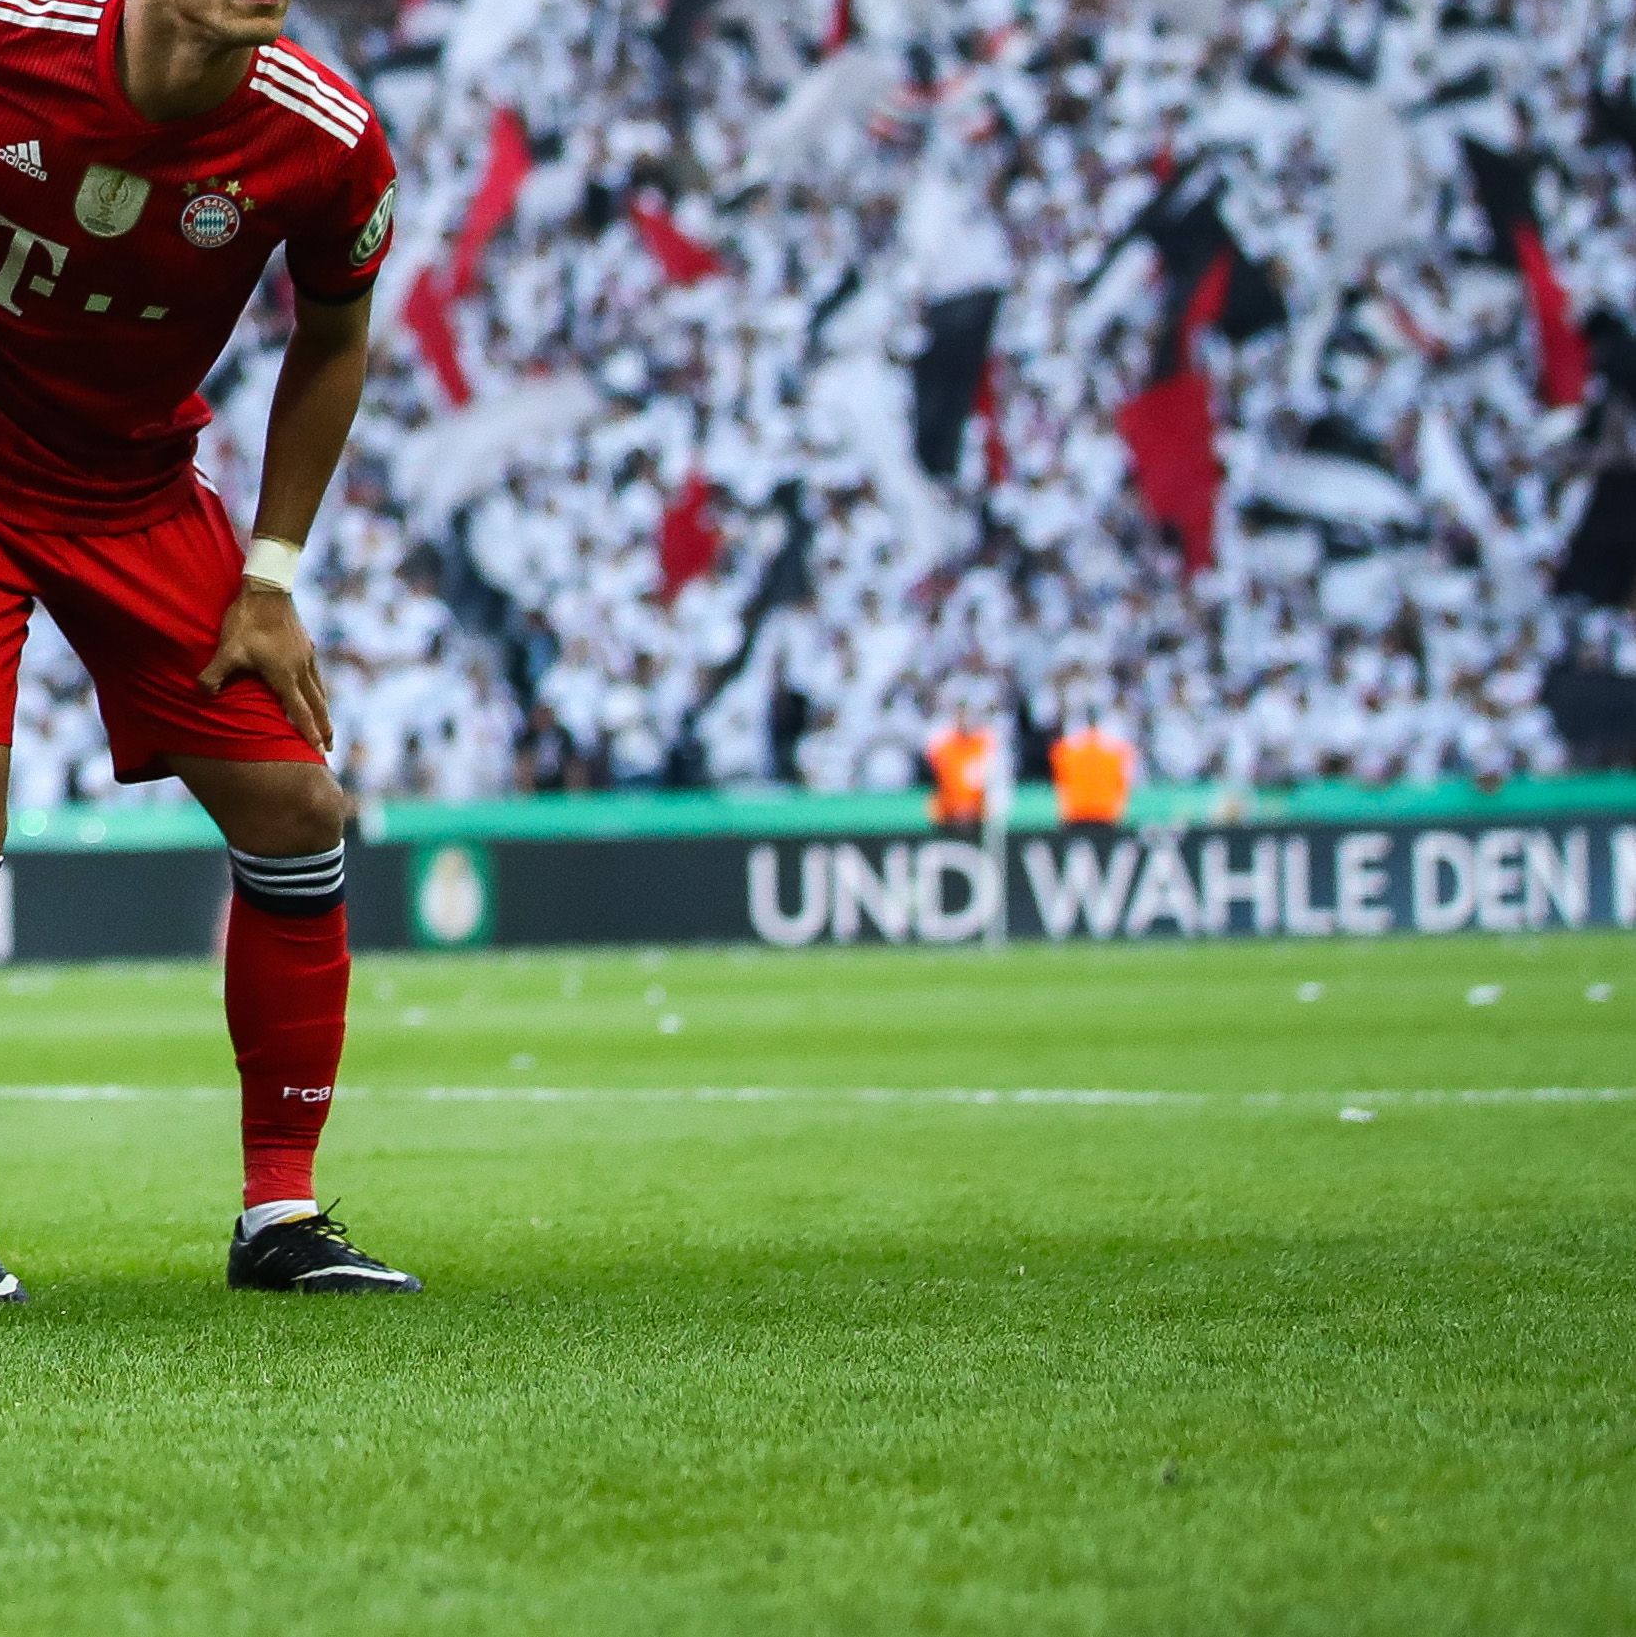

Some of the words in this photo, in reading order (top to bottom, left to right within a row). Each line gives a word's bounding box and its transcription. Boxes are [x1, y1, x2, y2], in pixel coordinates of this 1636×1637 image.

[747, 840, 1009, 947] UND
[1022, 820, 1395, 941] WÄHLE
[1411, 827, 1591, 934] DEN
[283, 1086, 332, 1102] FCB
